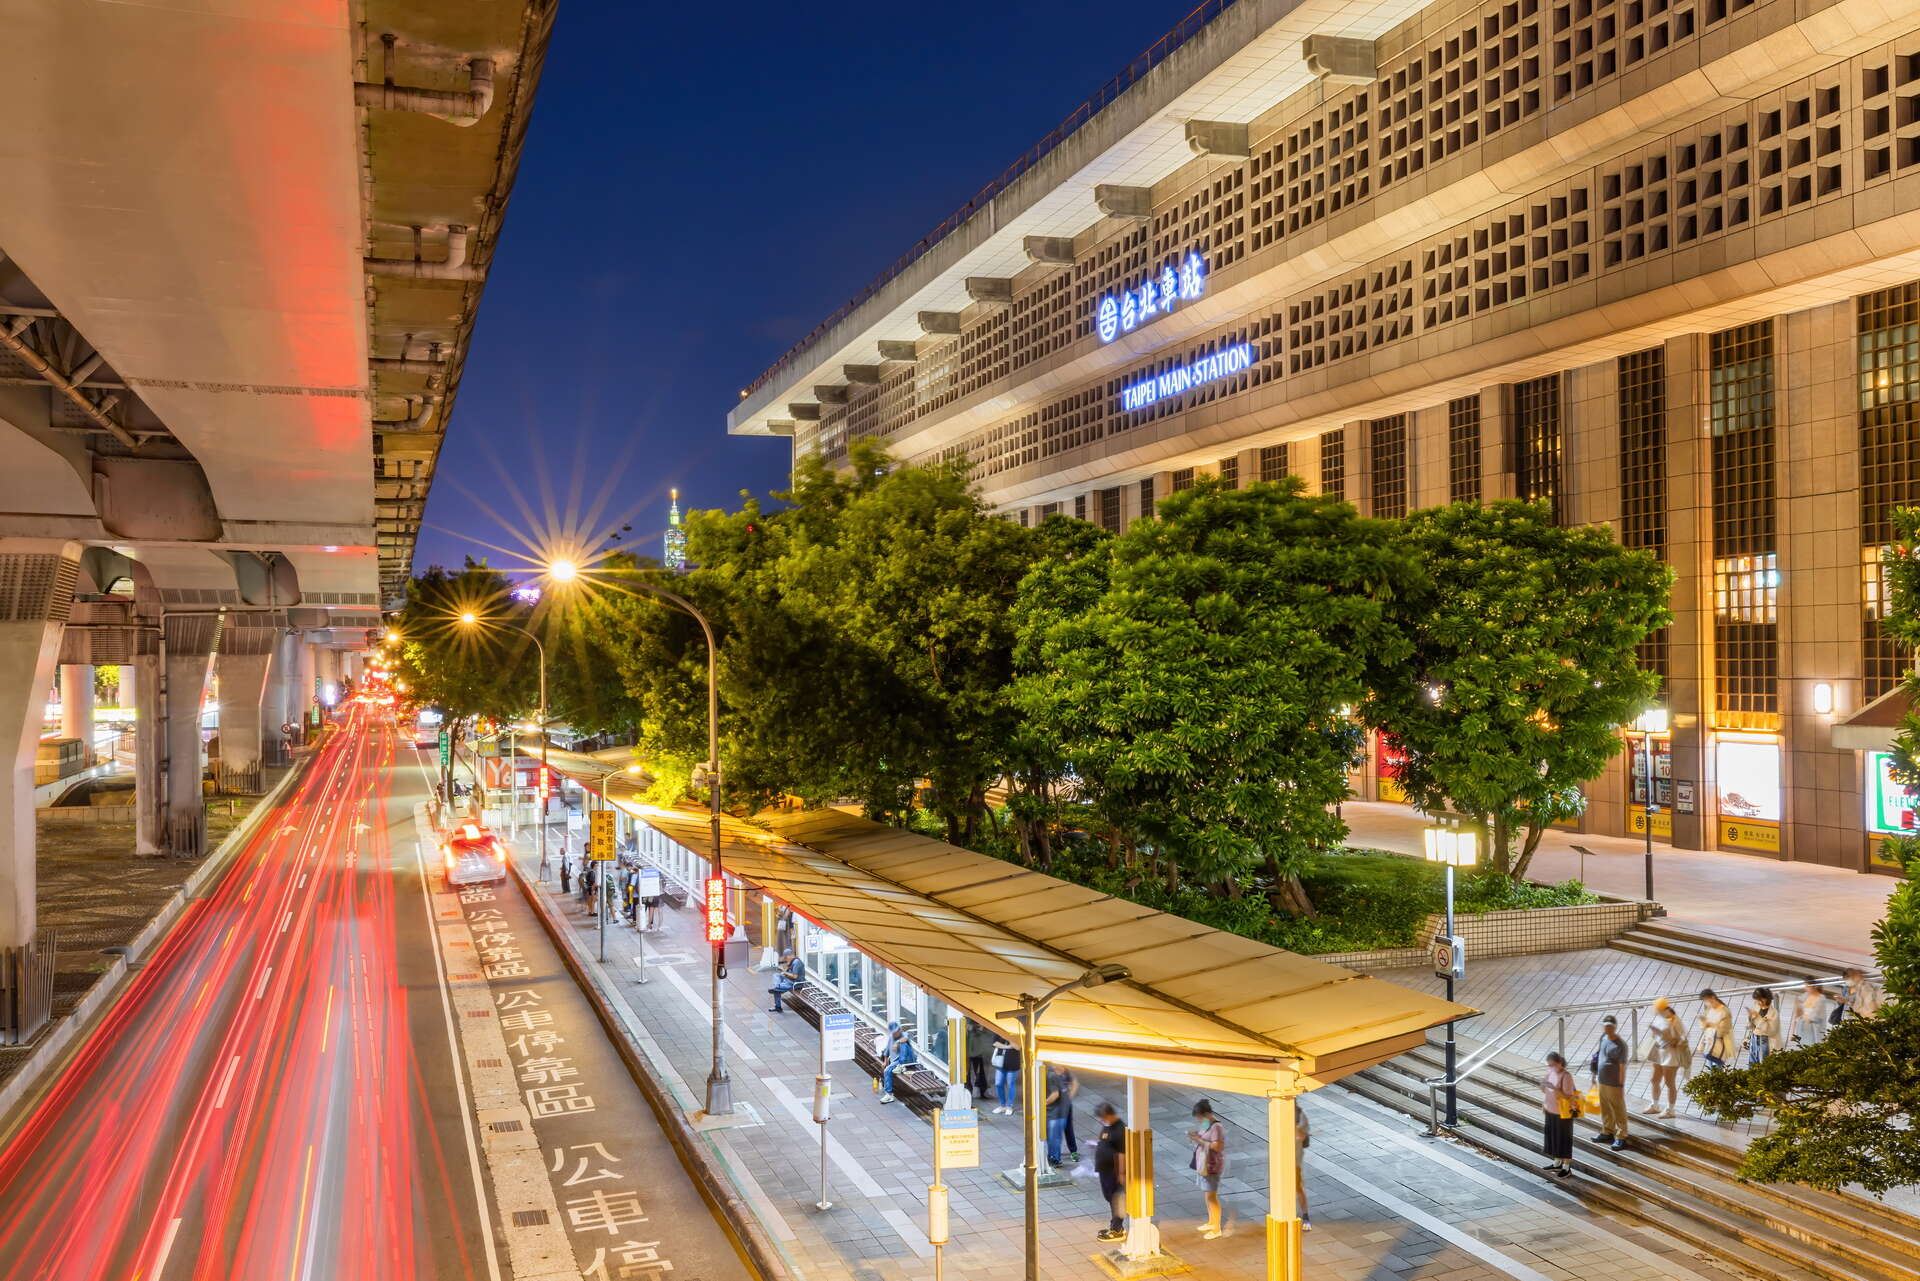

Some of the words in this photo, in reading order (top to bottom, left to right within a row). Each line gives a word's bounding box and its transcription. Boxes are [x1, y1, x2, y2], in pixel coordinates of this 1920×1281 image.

[1121, 253, 1202, 331] 台北車站
[1123, 380, 1157, 410] TAIPEI
[1159, 365, 1191, 399] MAIN
[1193, 343, 1250, 386] STATION
[468, 908, 531, 980] 公車停靠區
[496, 988, 596, 1120] 公車停靠區
[551, 1141, 675, 1281] 公車停
